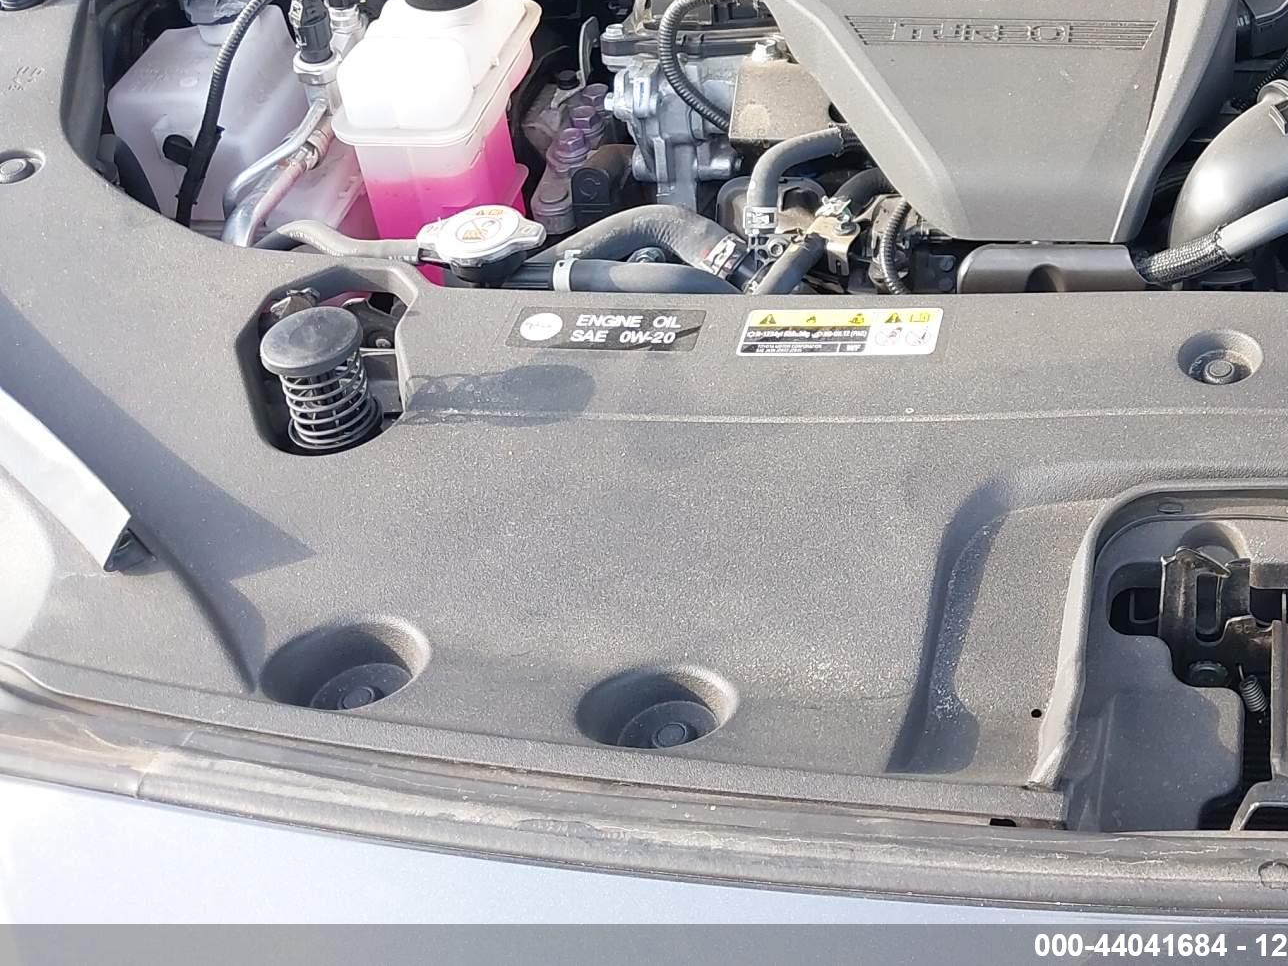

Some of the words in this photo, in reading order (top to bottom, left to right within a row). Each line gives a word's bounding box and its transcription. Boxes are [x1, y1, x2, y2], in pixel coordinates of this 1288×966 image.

[575, 314, 644, 328] ENGINE
[652, 315, 682, 329] OIL
[569, 330, 607, 343] SAE
[619, 331, 677, 344] 0W-20
